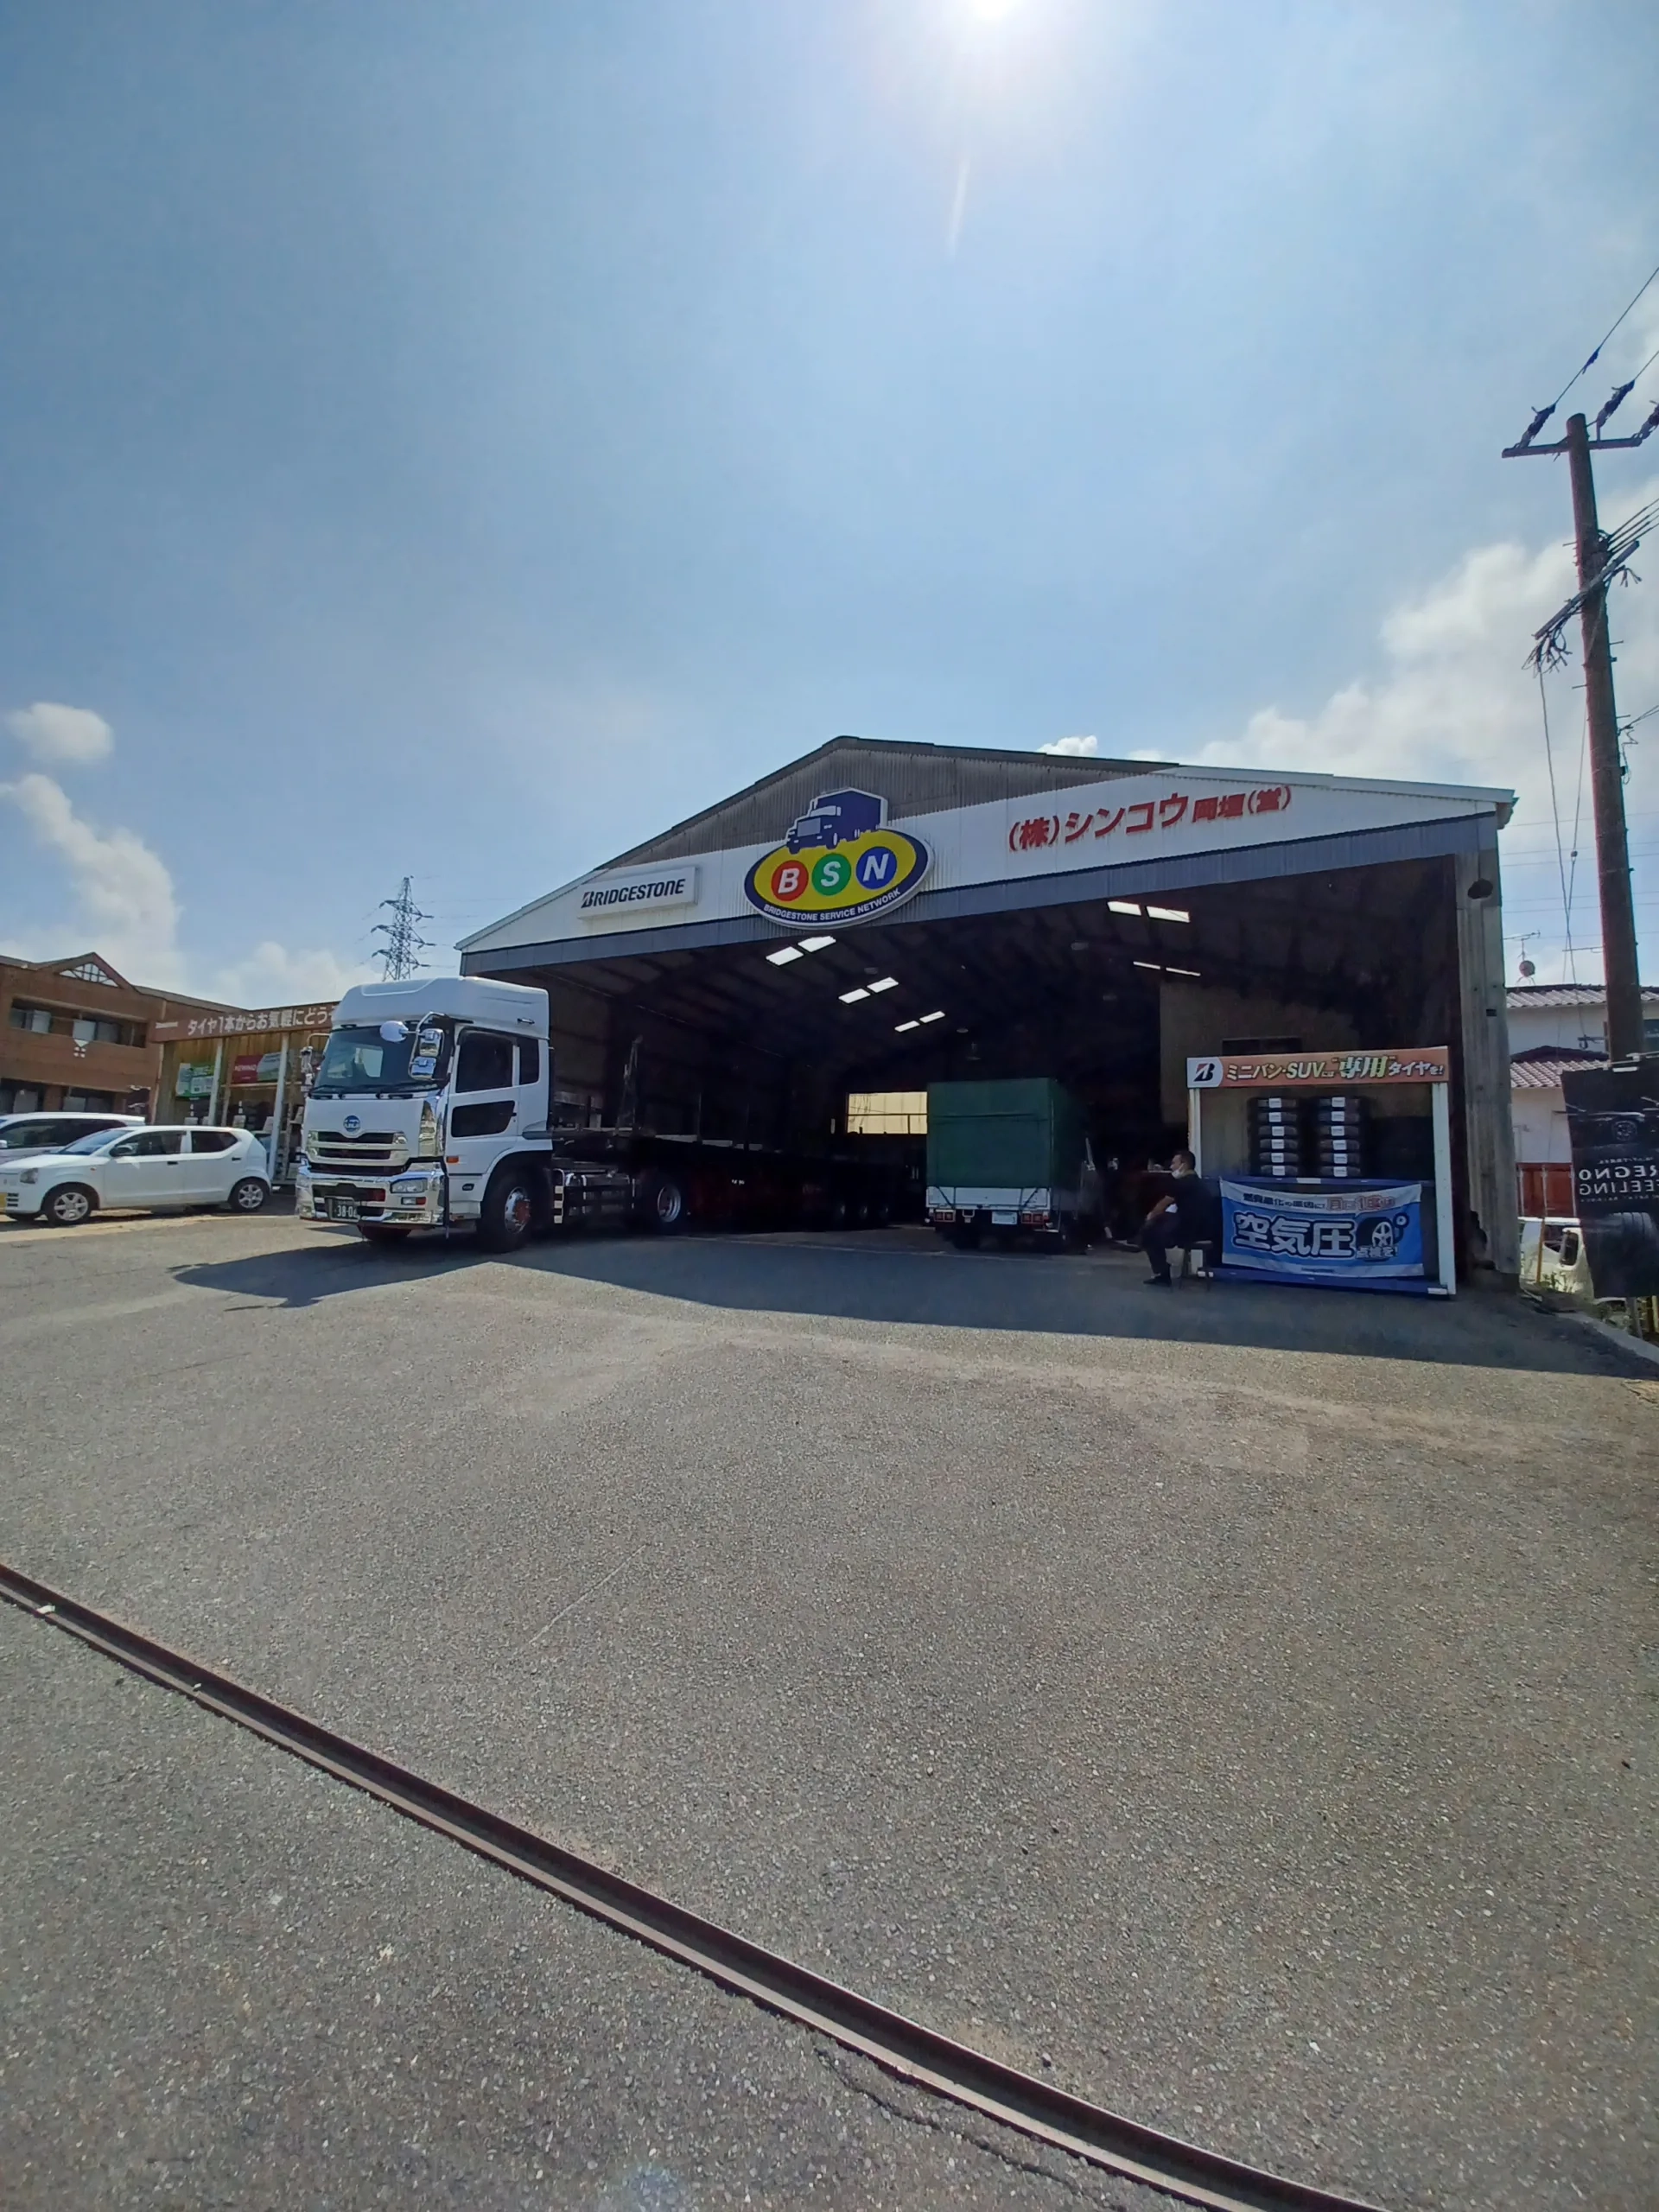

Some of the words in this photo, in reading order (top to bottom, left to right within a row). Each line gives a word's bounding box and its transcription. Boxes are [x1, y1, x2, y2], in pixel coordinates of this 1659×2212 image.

[581, 879, 685, 908] BRIDGESTONE
[764, 904, 817, 921] BRIDGESTONE
[820, 908, 855, 921] SERVICE
[857, 887, 900, 913] NETWORK
[1232, 1212, 1355, 1258] 空気圧
